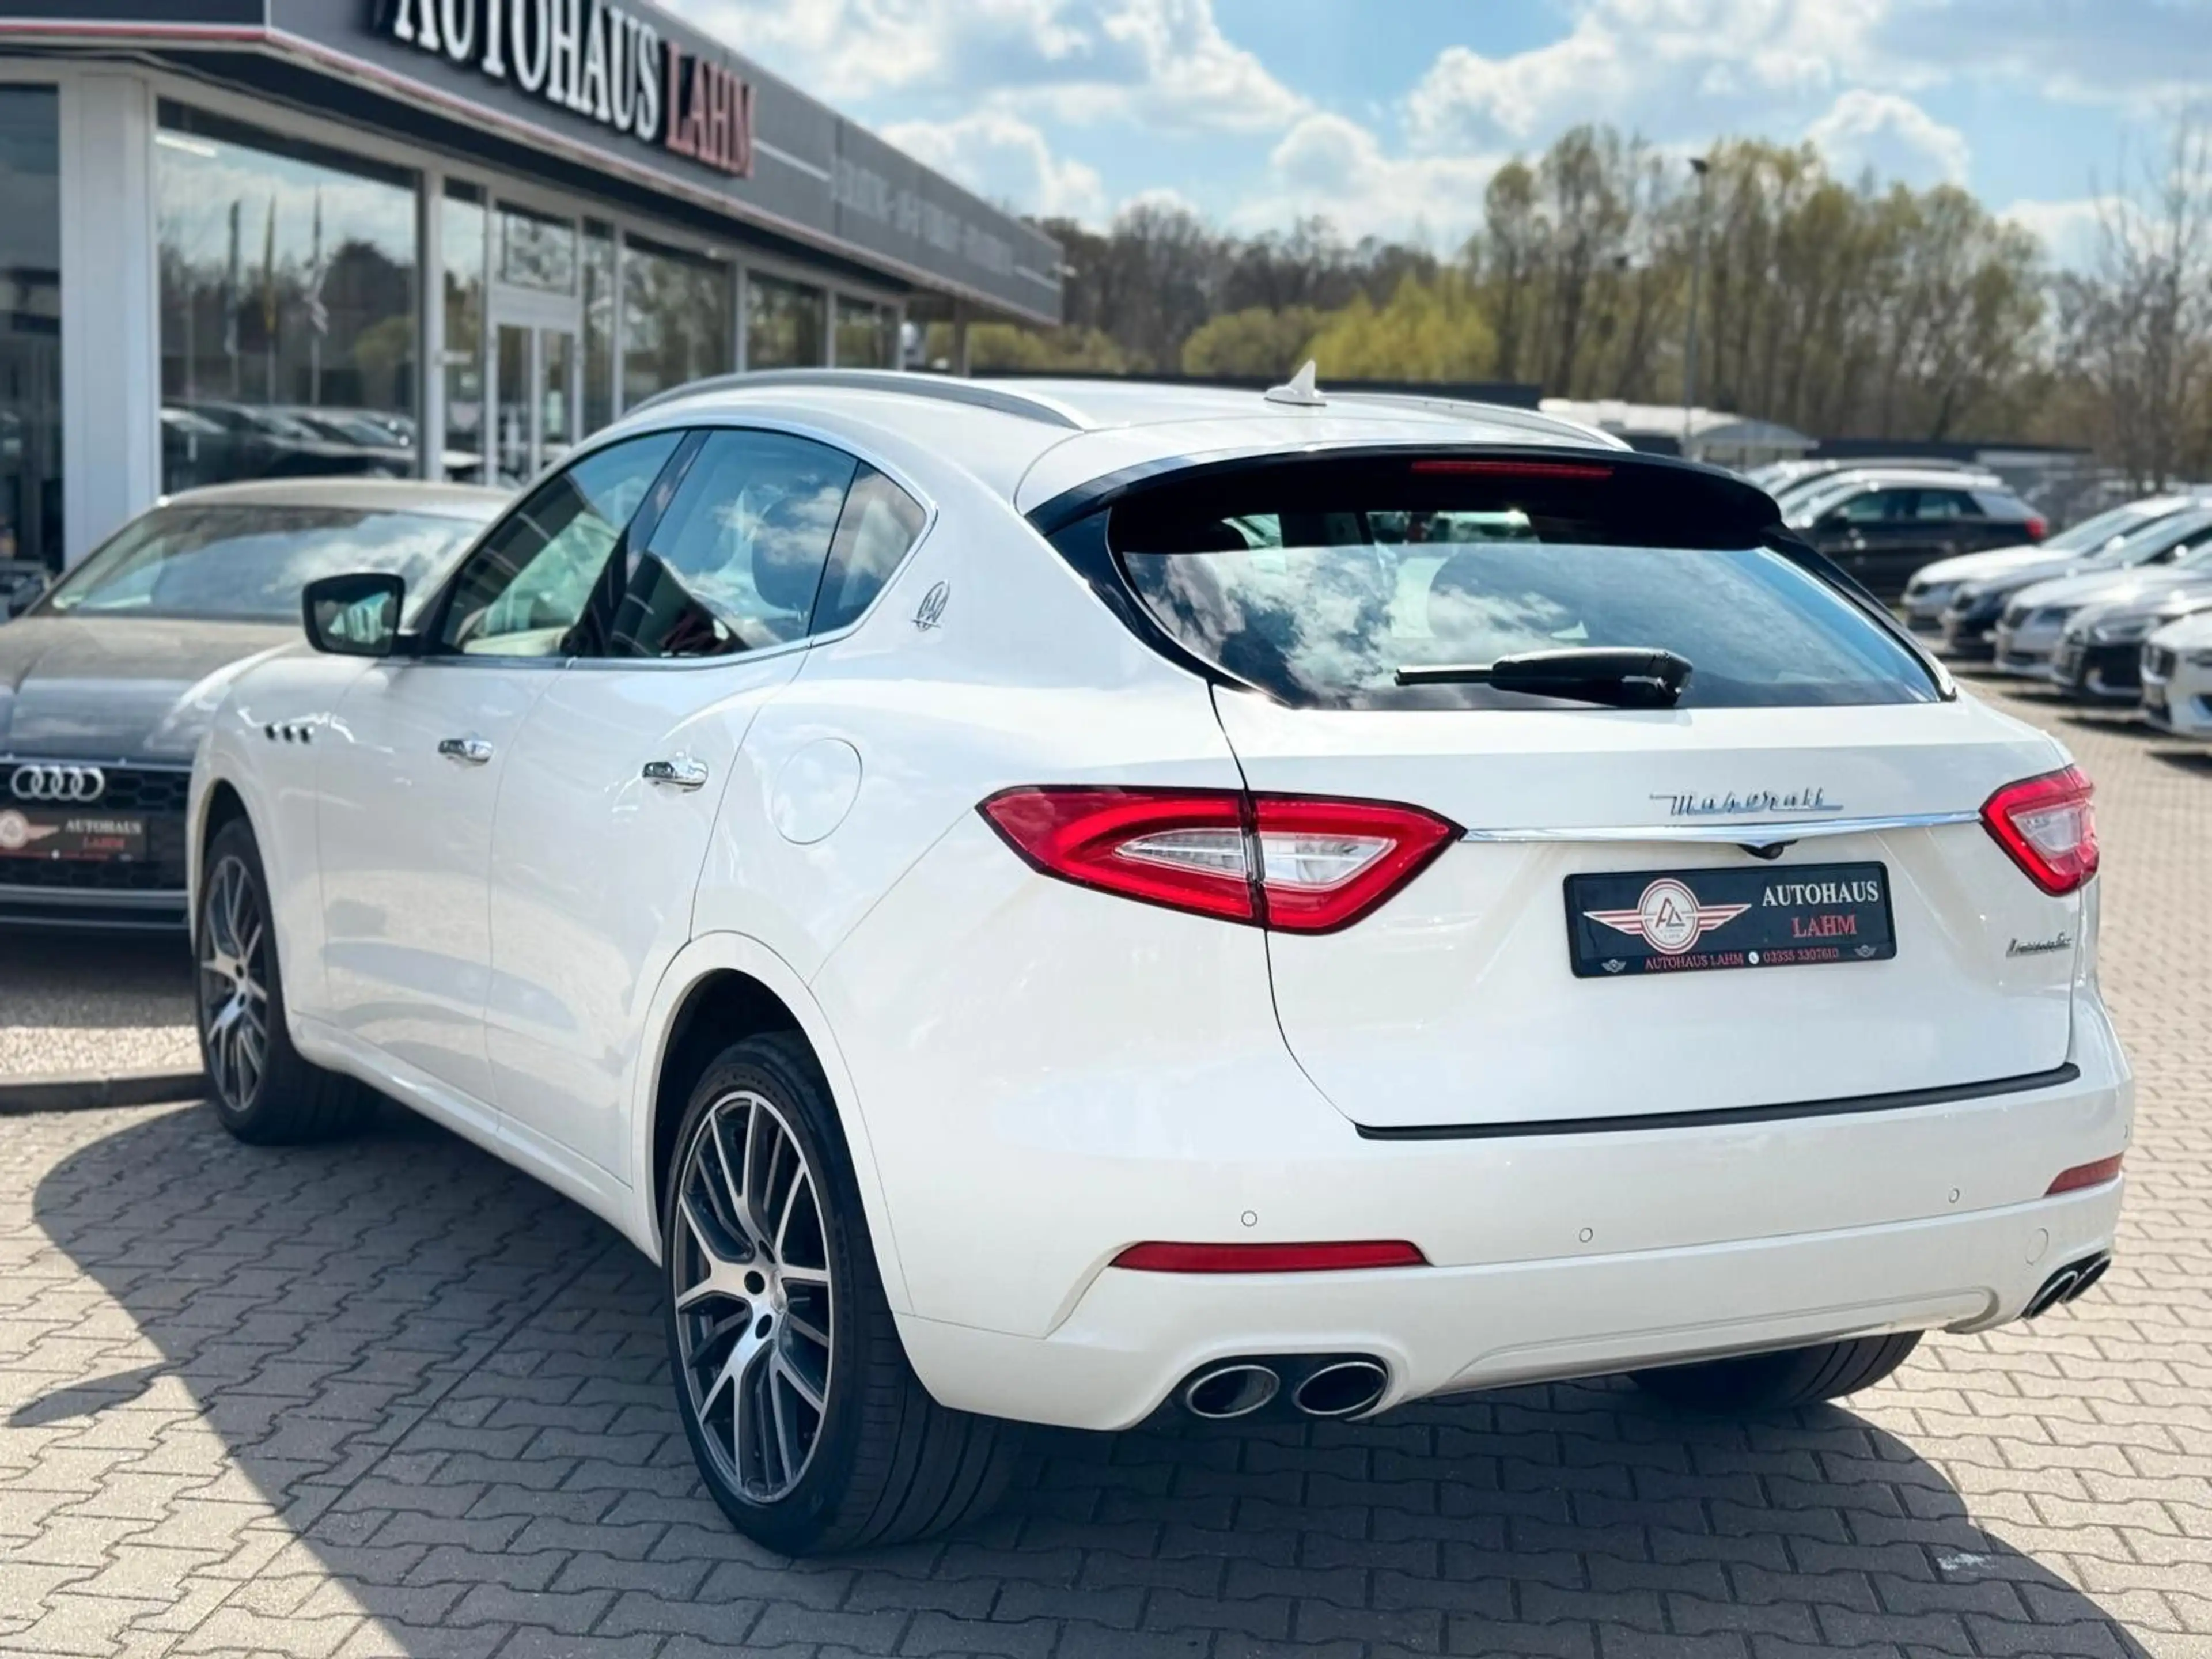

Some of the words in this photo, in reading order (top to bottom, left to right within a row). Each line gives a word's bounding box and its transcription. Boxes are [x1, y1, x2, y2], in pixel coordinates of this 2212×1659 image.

[666, 39, 756, 177] LAHM
[1762, 881, 1879, 907] AUTOHAUS
[1791, 914, 1857, 938] LAHM
[1645, 953, 1708, 971] AUTOHAUS
[1710, 952, 1744, 966] LAHM
